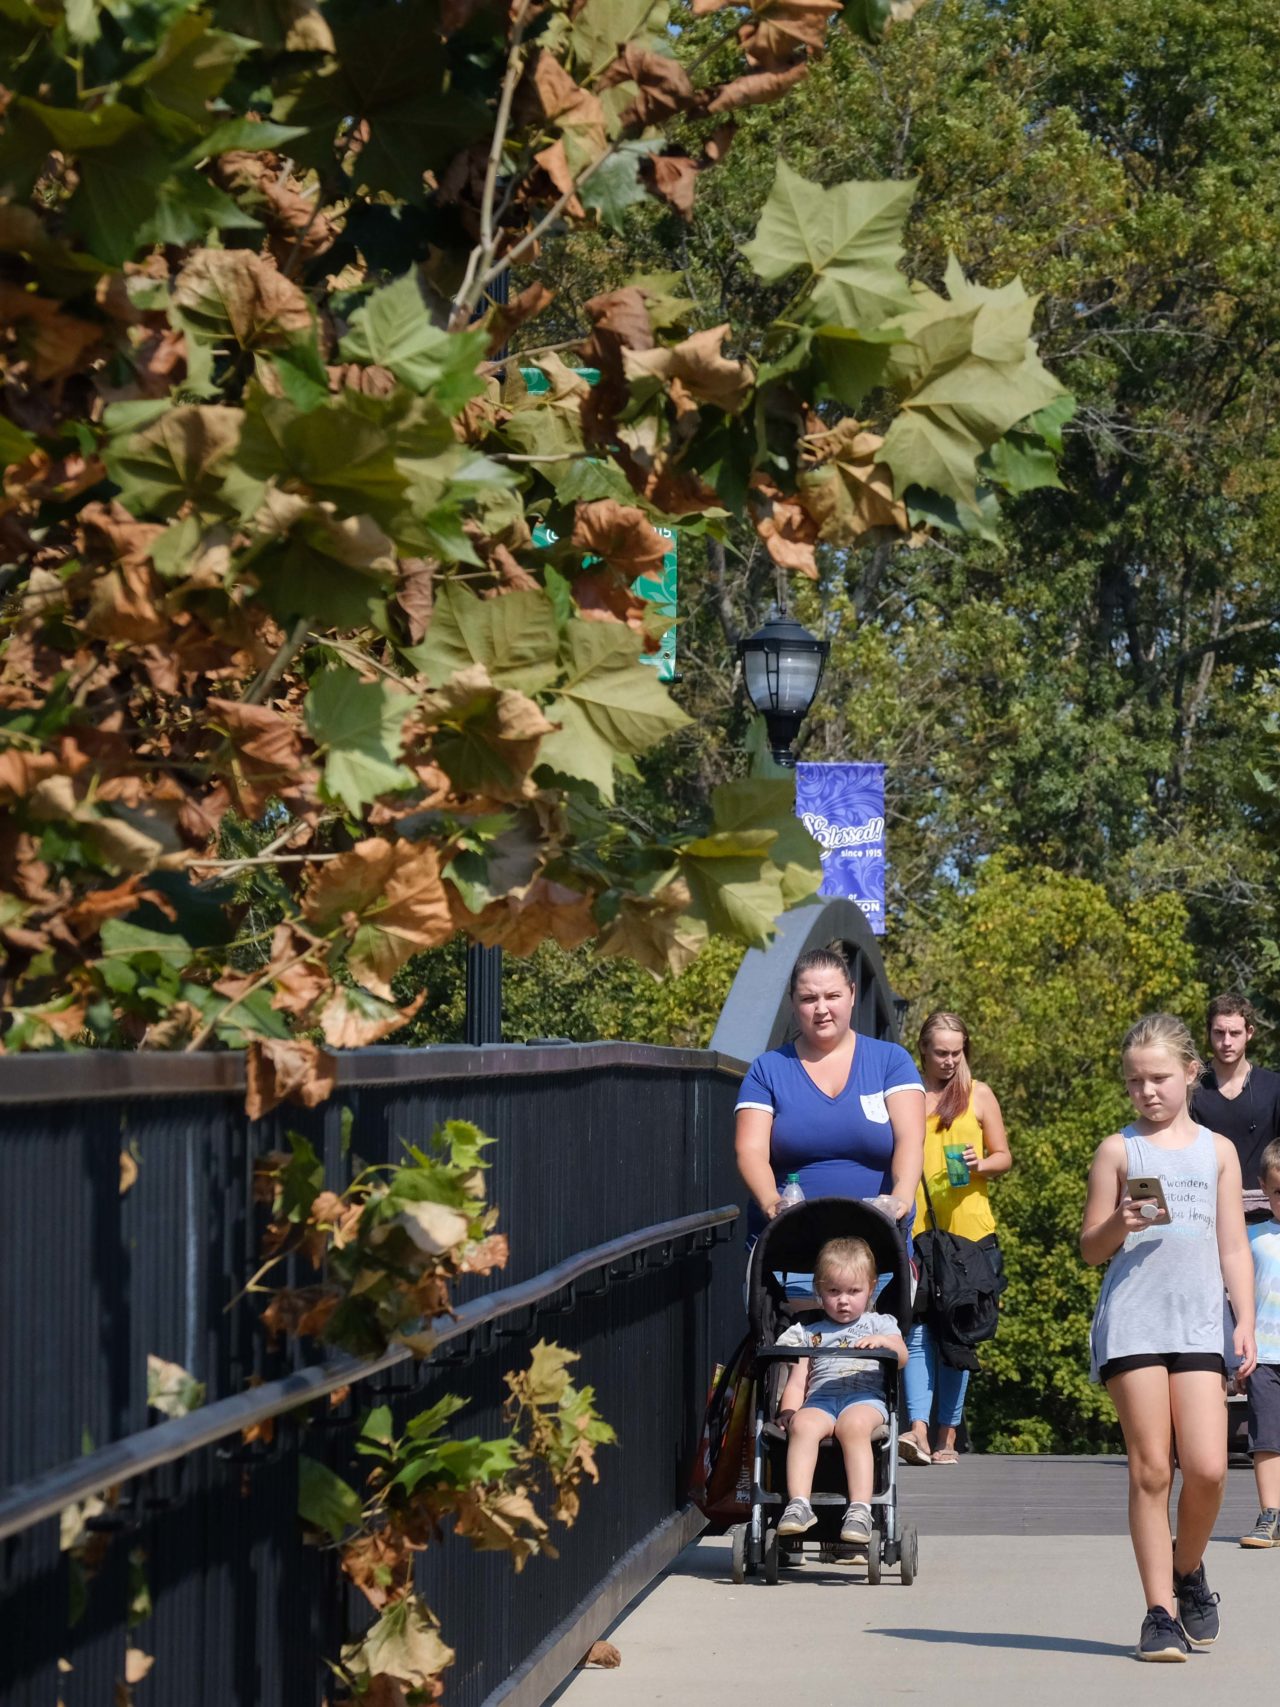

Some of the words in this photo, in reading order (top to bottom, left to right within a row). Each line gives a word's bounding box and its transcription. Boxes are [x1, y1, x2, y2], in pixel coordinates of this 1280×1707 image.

[841, 849, 863, 858] since
[865, 849, 882, 858] 1915
[1167, 1179, 1208, 1190] wonders
